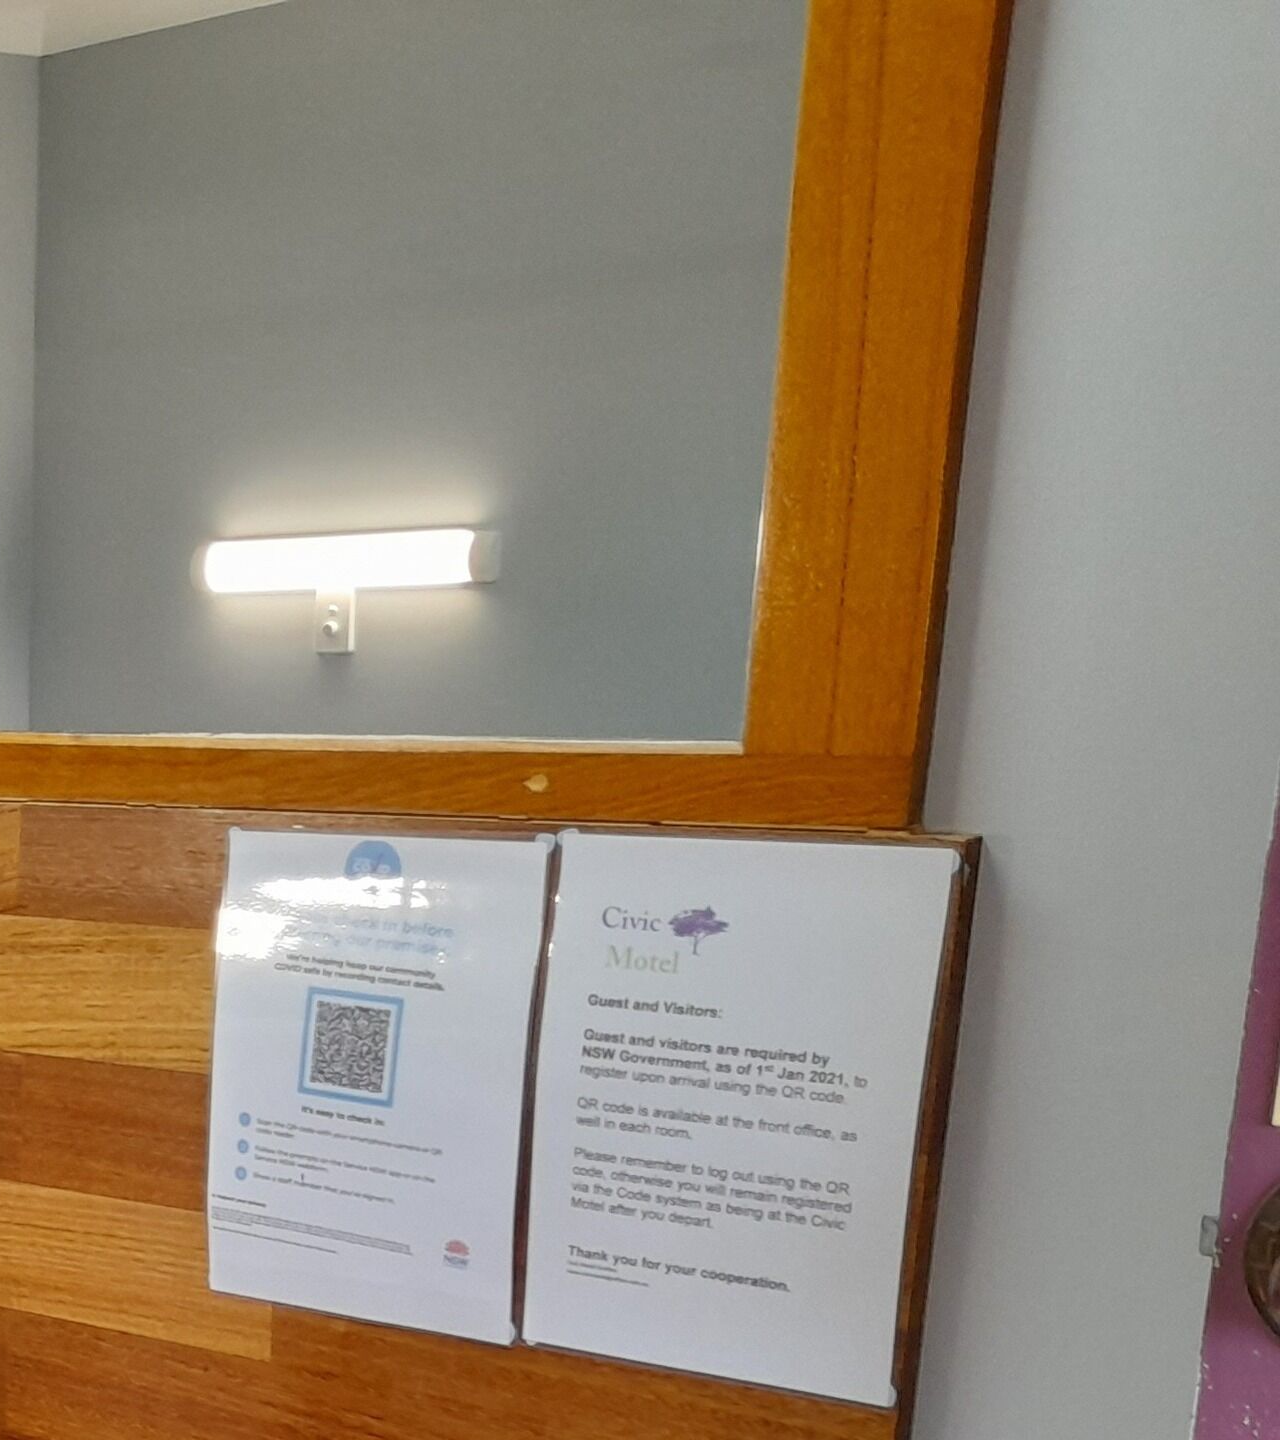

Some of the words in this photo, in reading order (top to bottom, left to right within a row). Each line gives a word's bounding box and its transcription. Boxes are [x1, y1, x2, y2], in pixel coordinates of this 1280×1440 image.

[602, 906, 662, 932] Civic
[605, 944, 680, 974] Motel
[587, 994, 629, 1009] Guest
[632, 1000, 659, 1013] and
[664, 1002, 723, 1019] Visitors:
[583, 1028, 625, 1044] Guest
[629, 1035, 655, 1048] and
[659, 1038, 712, 1054] visitors
[716, 1045, 740, 1056] are
[744, 1047, 807, 1063] required
[812, 1052, 831, 1068] by
[580, 1064, 628, 1080] register
[632, 1071, 665, 1084] upon
[669, 1075, 710, 1089] arrival
[714, 1081, 751, 1097] using
[755, 1083, 778, 1097] the
[781, 1085, 805, 1099] QR
[581, 1045, 616, 1060] NSW
[715, 1063, 732, 1074] as
[736, 1063, 752, 1075] of
[777, 1067, 805, 1081] Jan
[854, 1076, 868, 1088] to
[577, 1096, 599, 1110] QR
[602, 1102, 635, 1115] code
[638, 1105, 649, 1117] is
[652, 1108, 712, 1125] available
[715, 1115, 729, 1127] at
[732, 1117, 754, 1130] the
[758, 1119, 790, 1134] front
[840, 1131, 858, 1143] as
[604, 1118, 616, 1129] in
[619, 1121, 651, 1134] each
[574, 1146, 617, 1163] Please
[621, 1156, 686, 1173] remember
[691, 1164, 704, 1176] to
[708, 1166, 728, 1182] log
[732, 1171, 754, 1183] out
[758, 1173, 796, 1191] using
[799, 1178, 822, 1192] the
[826, 1181, 851, 1196] QR
[570, 1196, 605, 1212] Motel
[608, 1203, 637, 1217] after
[641, 1209, 665, 1221] you
[571, 1182, 589, 1193] via
[593, 1184, 613, 1197] the
[616, 1186, 652, 1202] Code
[655, 1194, 702, 1209] system
[706, 1202, 721, 1213] as
[726, 1203, 764, 1222] being
[768, 1210, 782, 1221] at
[785, 1211, 807, 1225] the
[811, 1214, 847, 1231] Civic
[610, 1171, 673, 1188] otherwise
[677, 1181, 701, 1193] you
[705, 1183, 726, 1196] will
[730, 1187, 778, 1203] remain
[781, 1194, 853, 1214] registered
[568, 1245, 608, 1261] Thank
[613, 1255, 638, 1267] you
[641, 1256, 662, 1270] for
[665, 1263, 697, 1275] your
